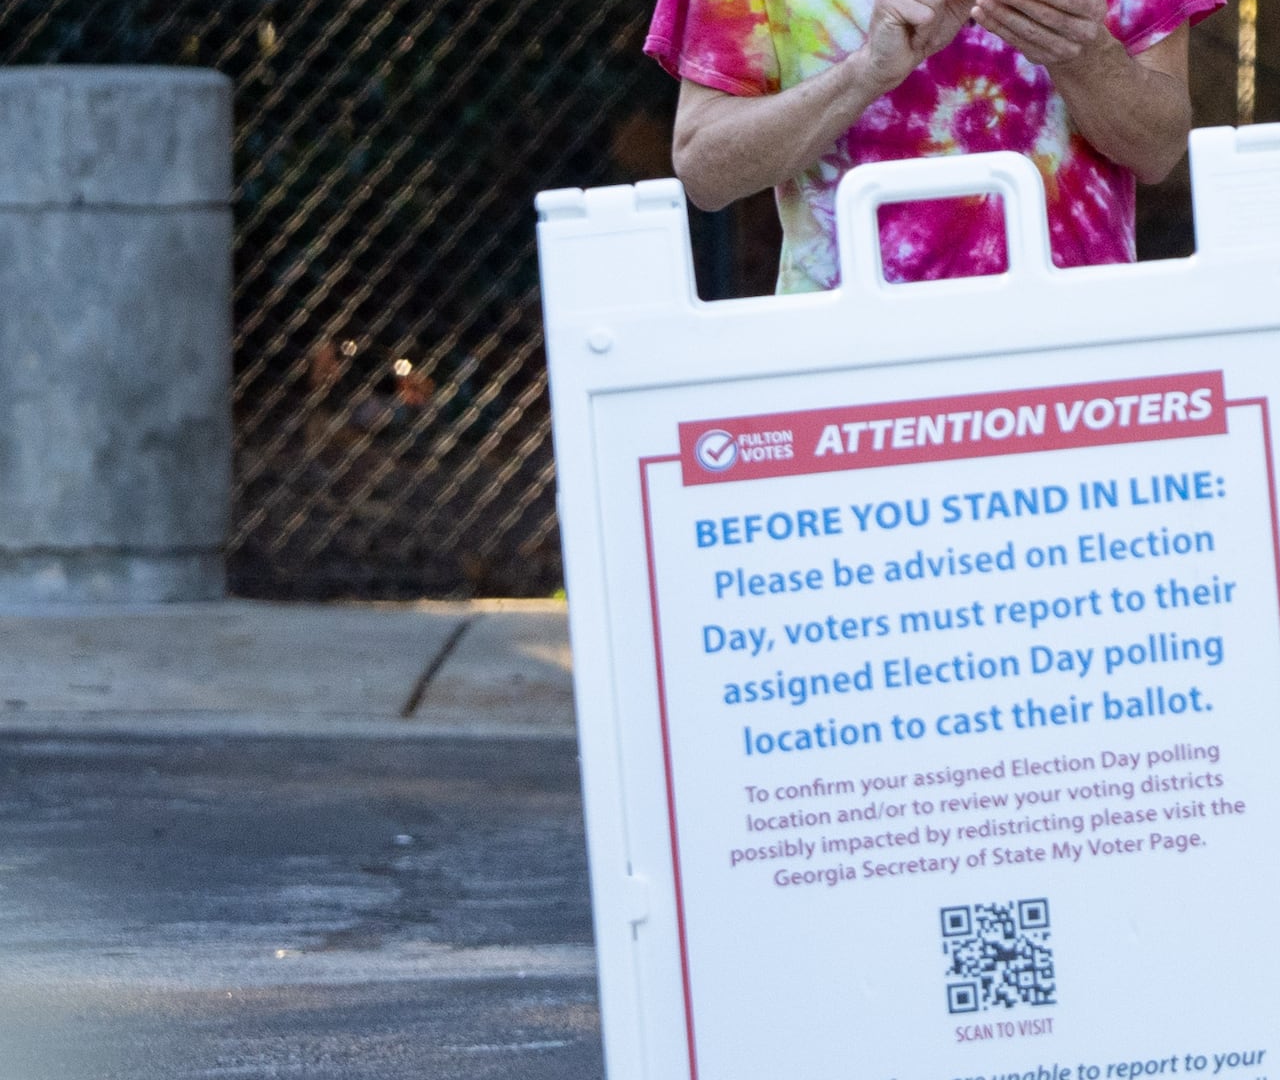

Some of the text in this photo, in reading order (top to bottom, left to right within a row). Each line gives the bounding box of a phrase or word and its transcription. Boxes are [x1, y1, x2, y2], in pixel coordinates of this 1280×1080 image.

[737, 430, 794, 446] FULTON
[739, 443, 795, 462] VOTES
[814, 387, 1213, 457] ATTENTION VOTERS
[696, 471, 1225, 548] BEFORE YOU STAND IN LINE:
[715, 531, 1214, 599] Please be advised on Election
[703, 579, 1236, 656] Day, voters must report to their
[724, 633, 1224, 706] assigned Election Day polling
[744, 686, 1213, 756] location to cast their ballot.
[745, 744, 1220, 803] To confirm your assigned Election Day polling
[747, 772, 1224, 832] location and/or to review your voting districts
[730, 798, 1246, 867] possibly impacted by redistricting please visit the
[774, 832, 1206, 887] Georgia Secretary of State My Voter Page.
[955, 1017, 1054, 1042] SCAN TO VISIT
[1077, 1064, 1100, 1080] to
[1106, 1054, 1179, 1080] report
[1185, 1053, 1208, 1072] to
[1213, 1049, 1267, 1075] your
